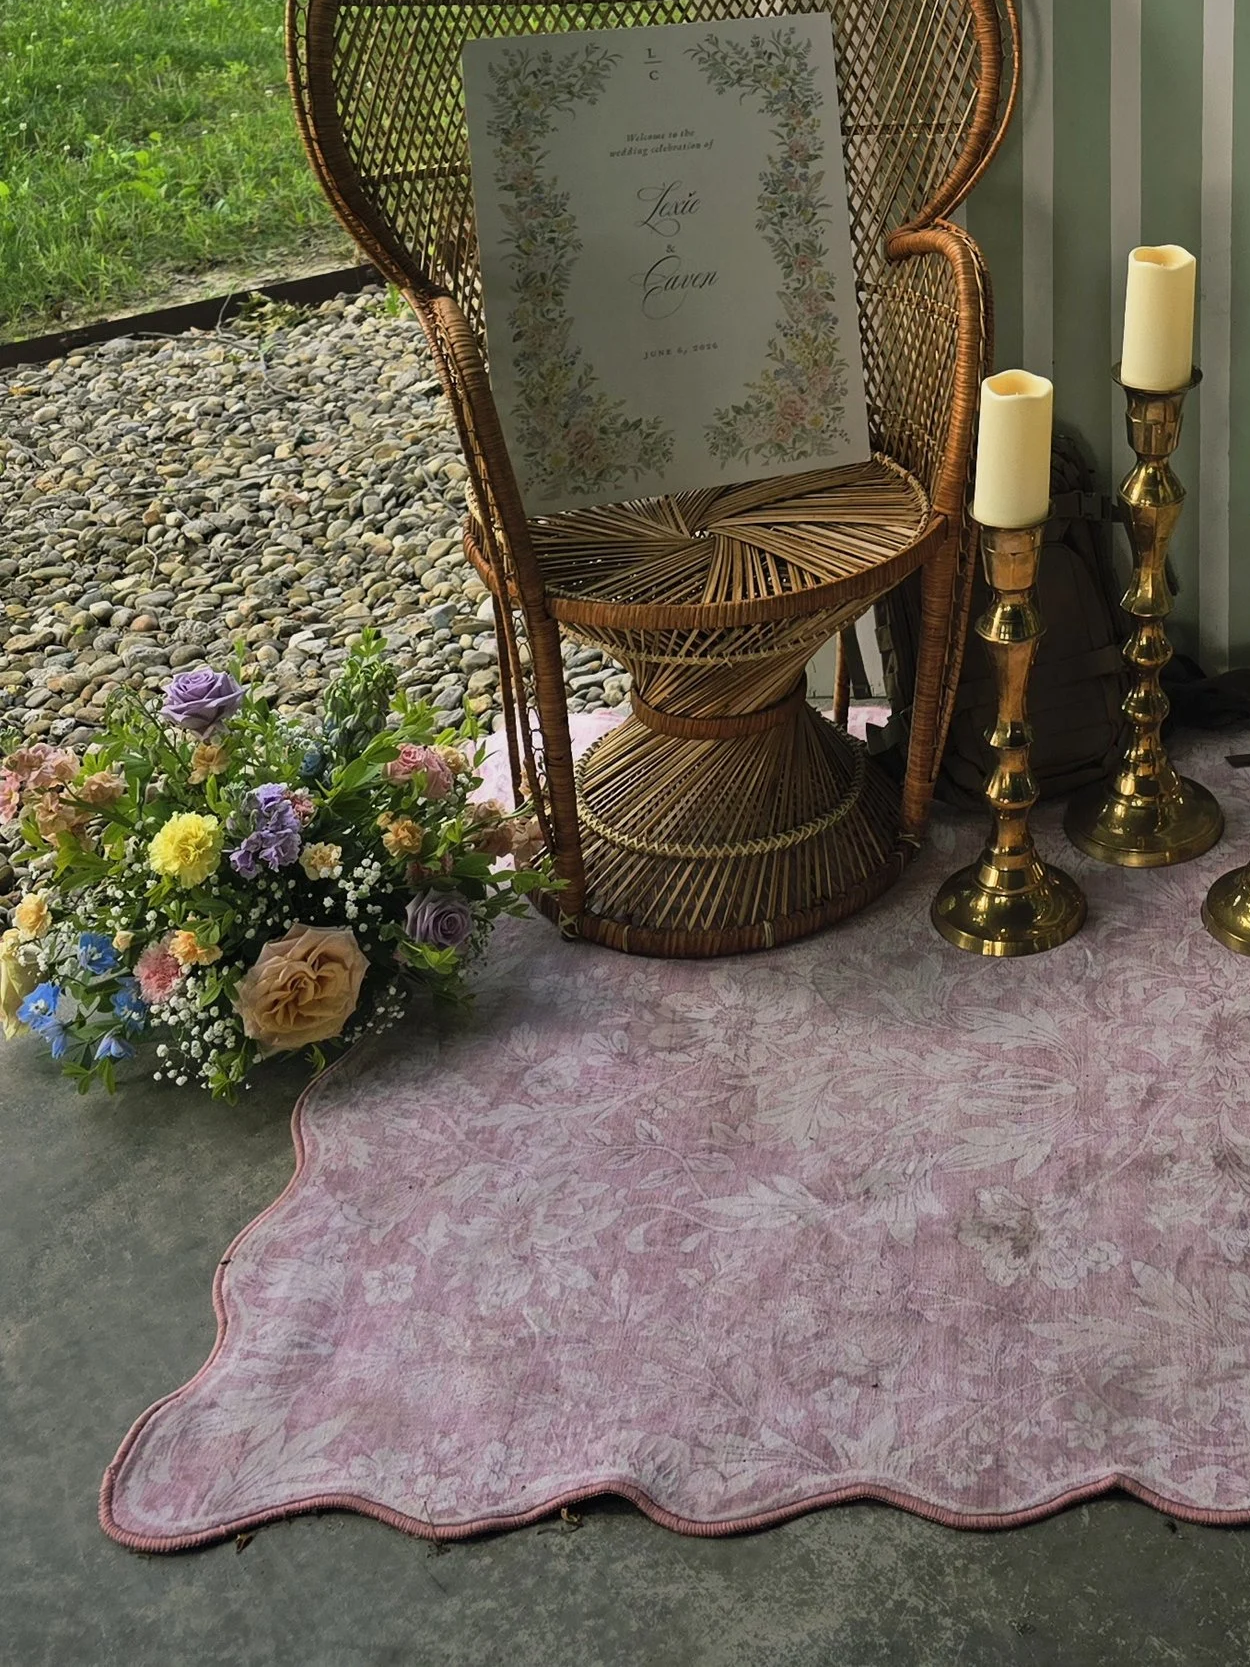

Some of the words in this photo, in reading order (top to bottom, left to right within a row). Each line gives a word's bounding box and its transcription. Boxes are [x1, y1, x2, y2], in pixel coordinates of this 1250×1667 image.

[646, 47, 657, 59] L
[648, 69, 660, 81] C
[626, 132, 666, 143] Welcome
[668, 131, 678, 139] to
[680, 128, 696, 138] the
[609, 146, 649, 158] wedding
[650, 142, 701, 154] celebration
[703, 138, 714, 151] of
[633, 179, 702, 238] Lexie
[665, 243, 676, 254] &
[642, 348, 672, 360] JUNE
[691, 341, 719, 353] 2026
